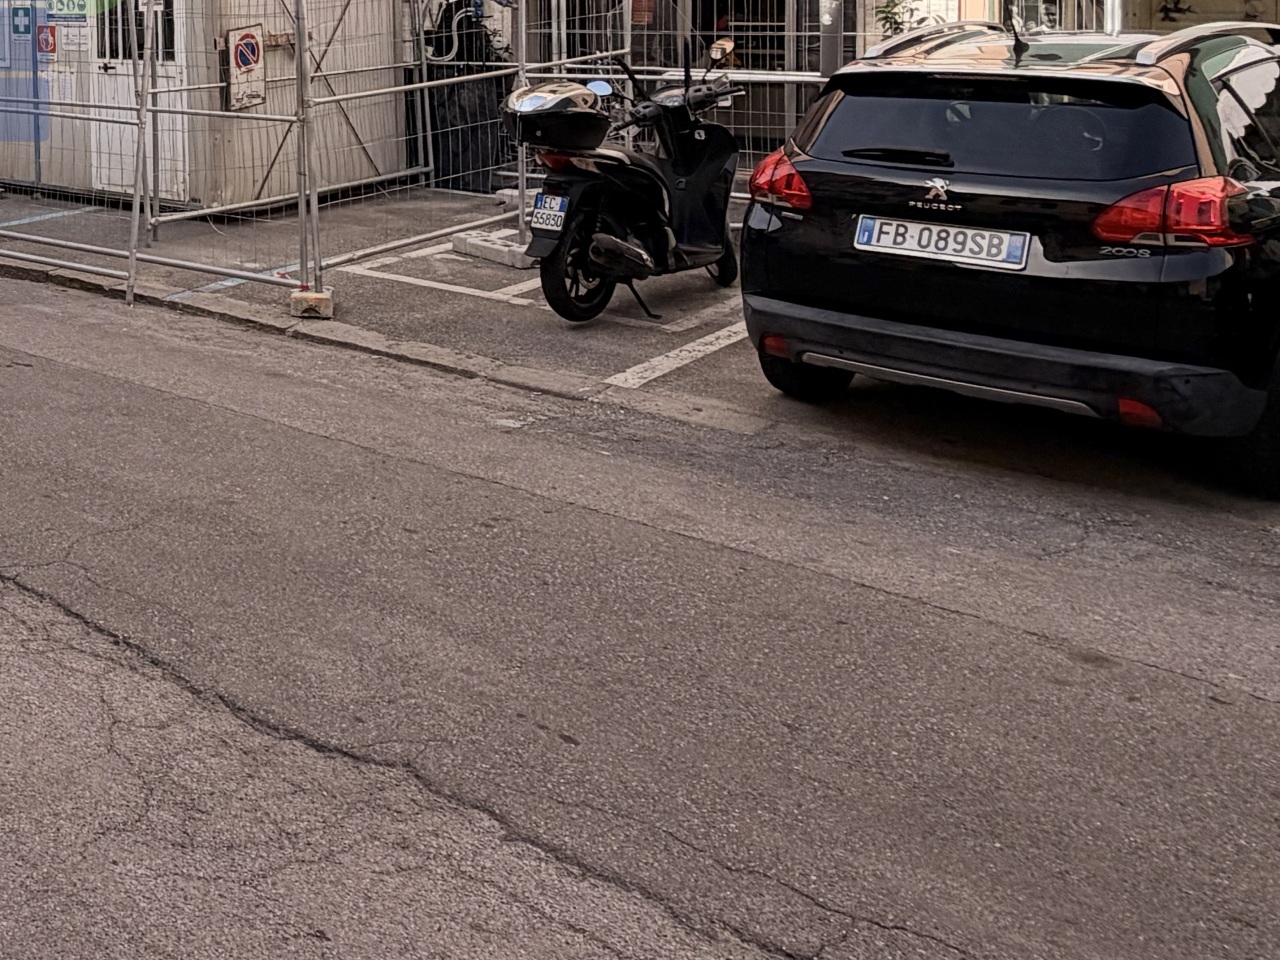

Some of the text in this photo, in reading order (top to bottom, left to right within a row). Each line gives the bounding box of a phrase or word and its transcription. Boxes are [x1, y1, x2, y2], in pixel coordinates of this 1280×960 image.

[543, 196, 556, 210] EC
[908, 201, 963, 211] PEUGEOT
[533, 211, 563, 228] 55830
[876, 221, 1004, 258] FB 089SB
[1099, 246, 1151, 258] 2008
